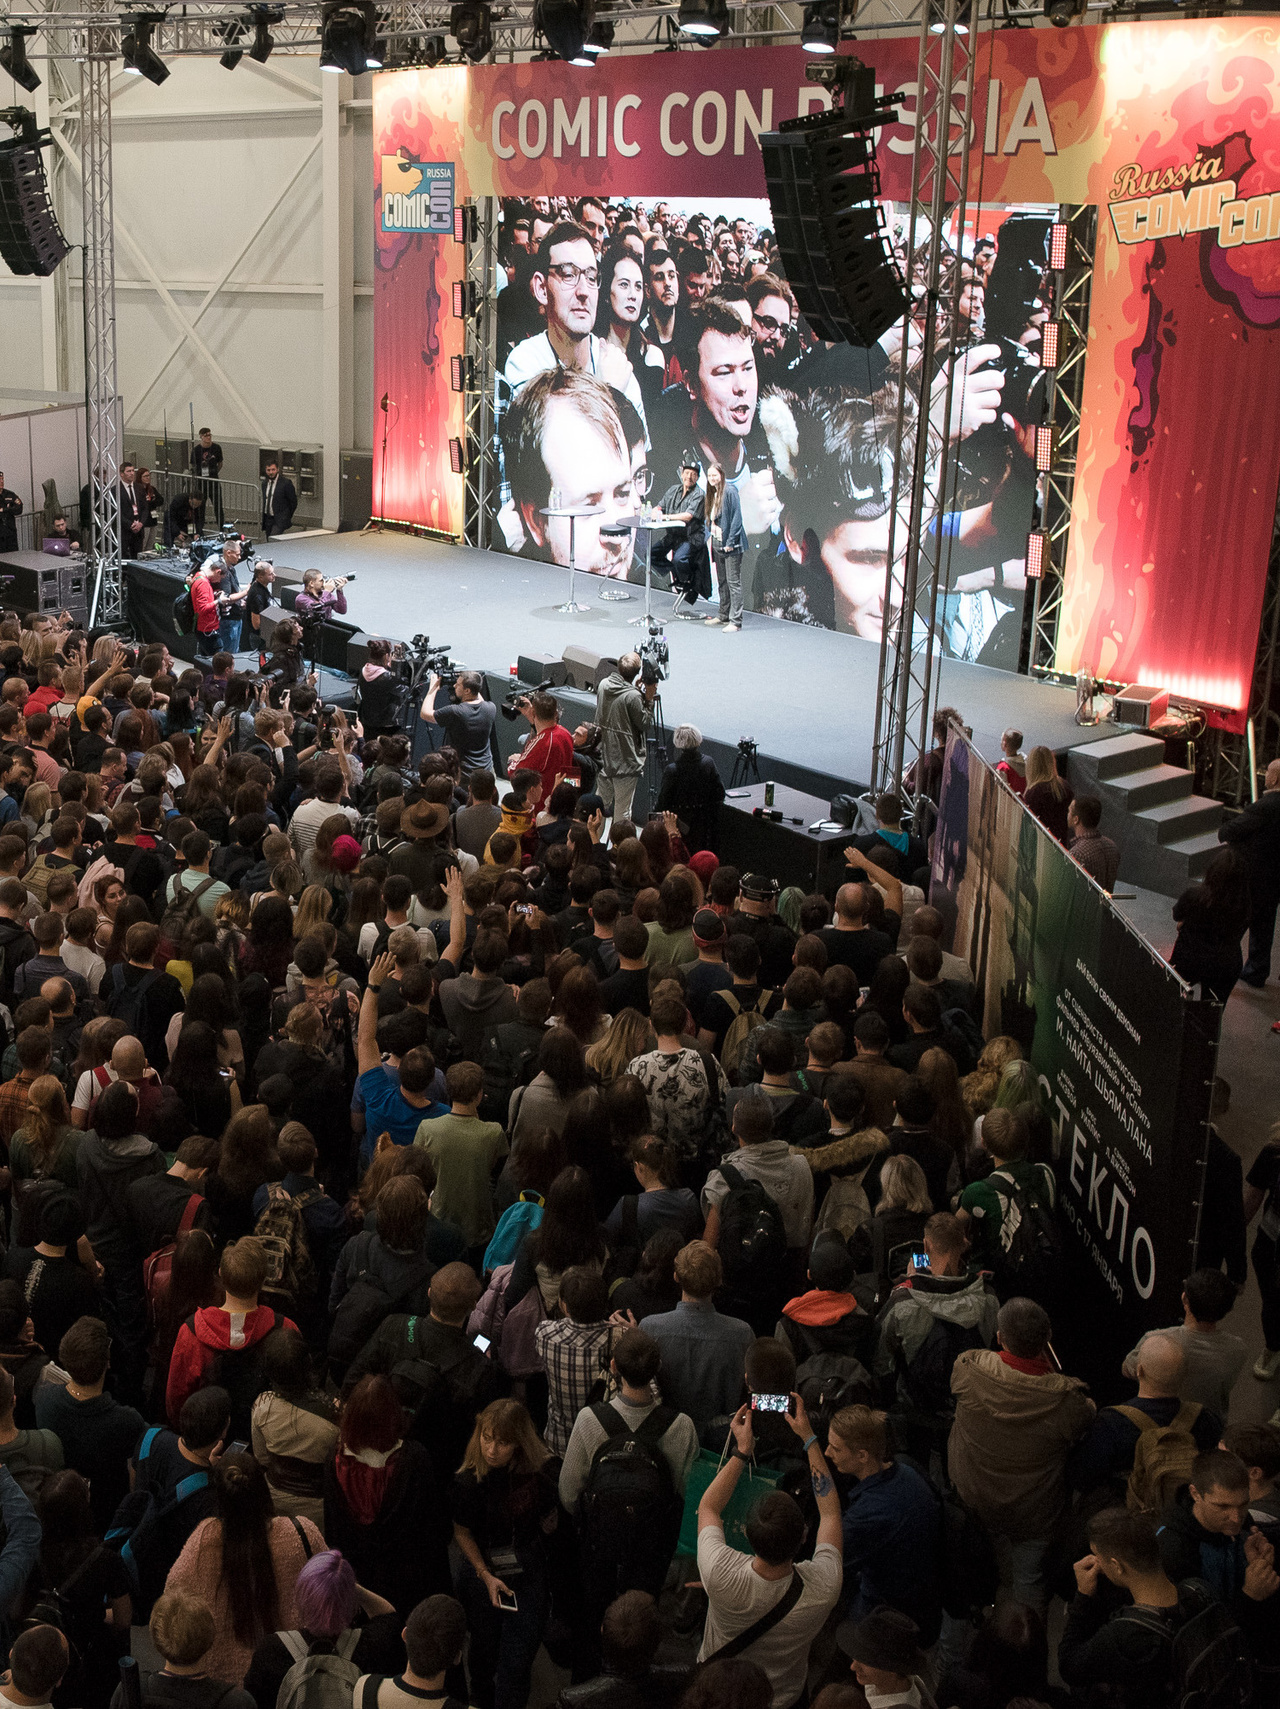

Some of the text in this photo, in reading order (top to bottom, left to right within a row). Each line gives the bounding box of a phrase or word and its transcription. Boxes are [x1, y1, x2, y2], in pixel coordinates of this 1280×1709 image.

[491, 94, 641, 160] COMIC
[660, 87, 776, 156] CON
[426, 168, 452, 178] RUSSIA
[1109, 152, 1223, 200] Russia
[384, 192, 430, 229] COMIC
[1108, 180, 1237, 245] COMIC
[1071, 998, 1103, 1044] сценариста
[1104, 1040, 1108, 1051] и
[1108, 1047, 1141, 1097] режиссера
[1099, 988, 1117, 1014] СВОИМ
[1116, 1008, 1141, 1045] ДЕМОНАМ
[1056, 1016, 1153, 1166] М. НАЙТА ШЬЯМАЛАНА
[1080, 1029, 1120, 1086] «Неуязвимый»
[1120, 1083, 1125, 1094] и
[1125, 1092, 1151, 1130] «Сплит»
[1111, 1154, 1136, 1198] ДЖЕКСОН
[1076, 1218, 1082, 1236] С
[1083, 1228, 1092, 1248] 17
[1091, 1242, 1123, 1305] ЯНВАРЯ
